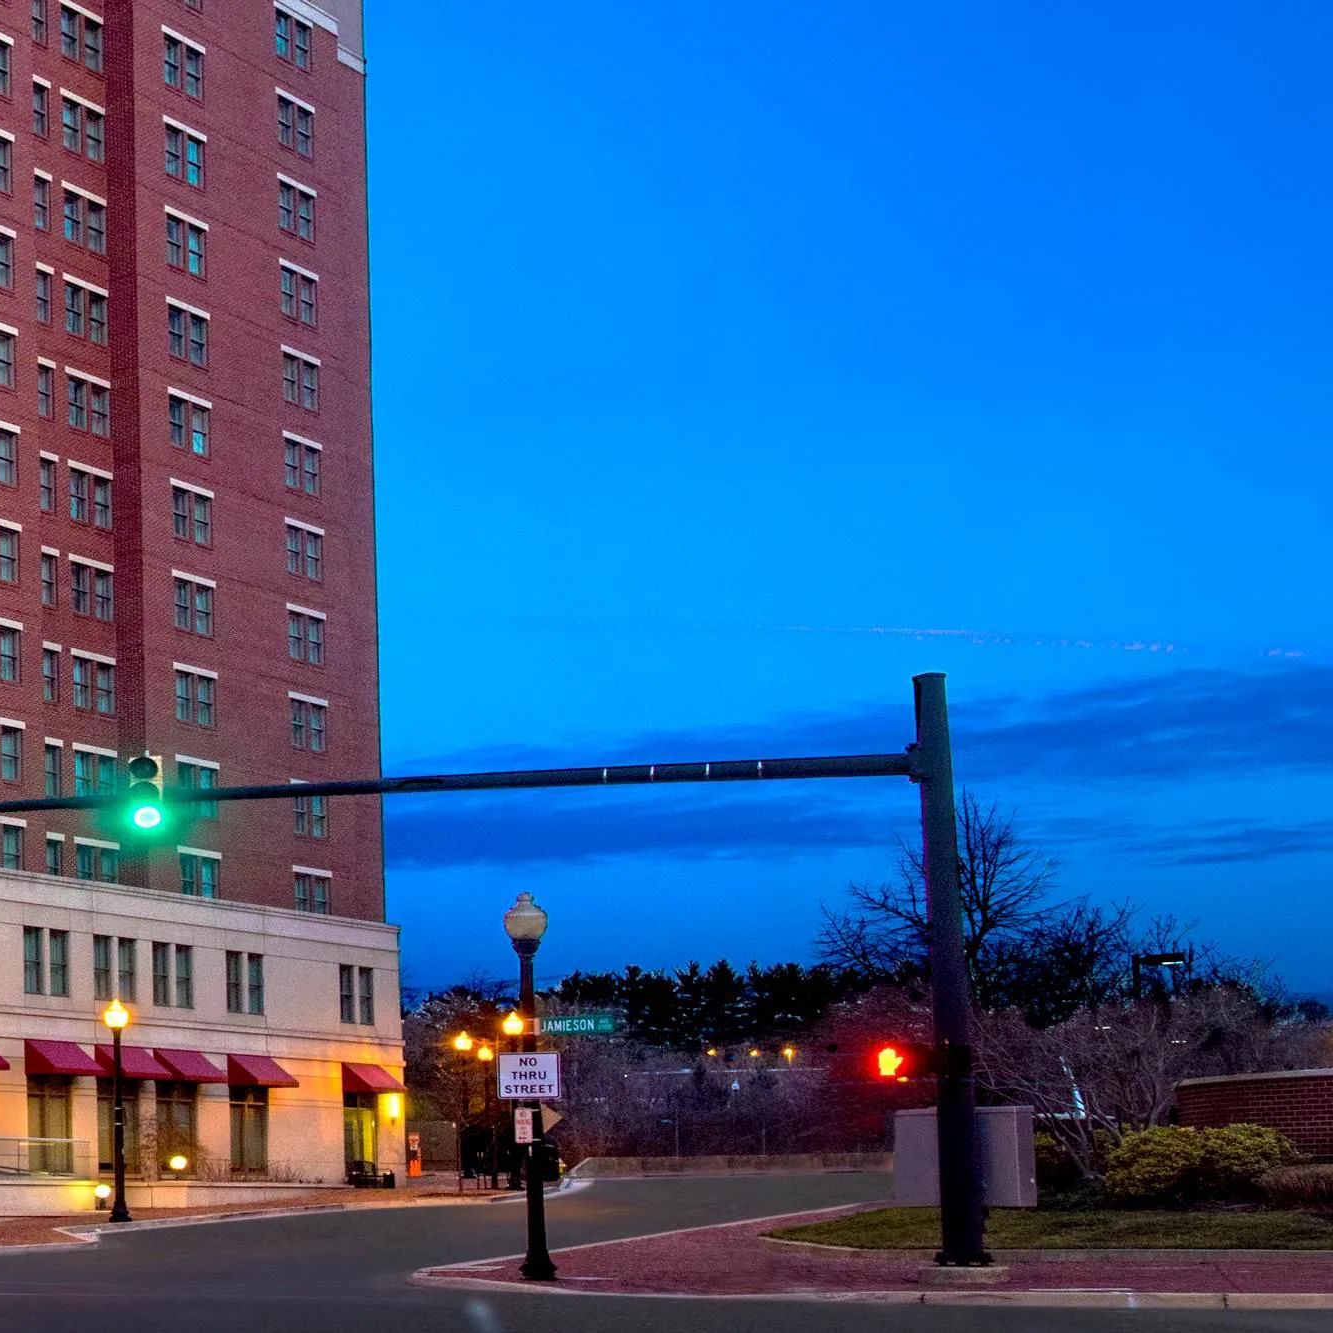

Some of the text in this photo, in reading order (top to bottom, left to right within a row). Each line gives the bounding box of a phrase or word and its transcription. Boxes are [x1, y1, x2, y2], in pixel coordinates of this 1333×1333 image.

[540, 1018, 595, 1032] JAMIESON
[519, 1057, 537, 1067] NO
[511, 1071, 547, 1080] THRU
[504, 1084, 554, 1094] STREET
